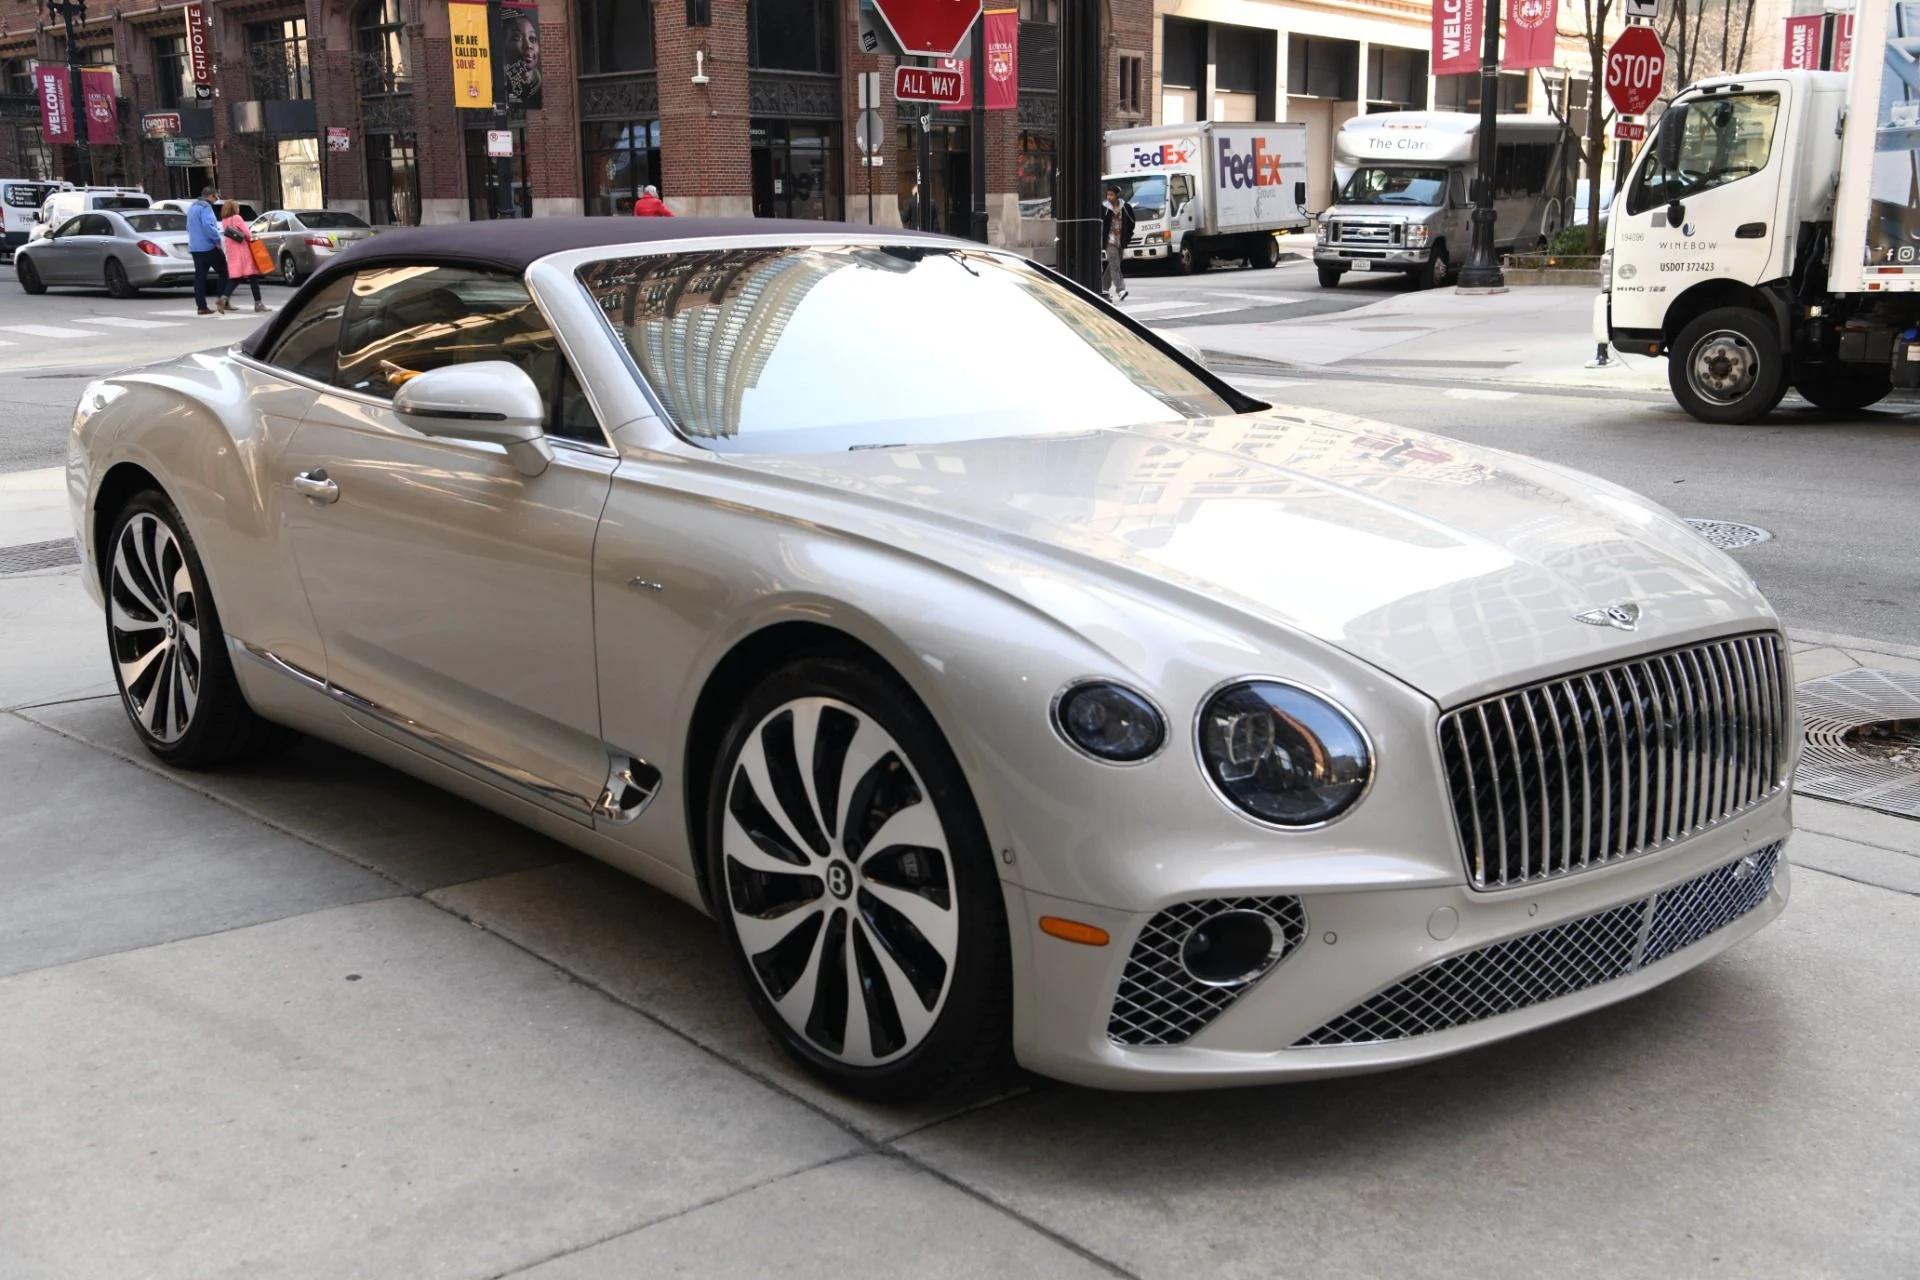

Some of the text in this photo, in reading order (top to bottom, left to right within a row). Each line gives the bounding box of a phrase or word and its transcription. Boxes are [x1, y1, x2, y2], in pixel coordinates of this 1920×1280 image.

[190, 8, 207, 80] CHIPOTLE
[454, 35, 478, 46] WE ARE
[1463, 24, 1473, 53] WATER
[988, 42, 1012, 50] LOYOLA
[455, 47, 488, 58] CALLED TO
[456, 60, 476, 69] SOLVE
[1609, 53, 1661, 89] STOP
[902, 74, 926, 94] ALL
[931, 76, 955, 96] WAY
[43, 75, 61, 135] WELCOME
[145, 118, 175, 129] CHIPOTLE
[1616, 125, 1642, 138] ALL WAY
[1368, 138, 1392, 149] The
[1131, 144, 1188, 168] FedEx
[1218, 137, 1282, 189] FedEx
[1660, 242, 1718, 250] WINEBOW
[1660, 262, 1715, 272] USDOT 372423
